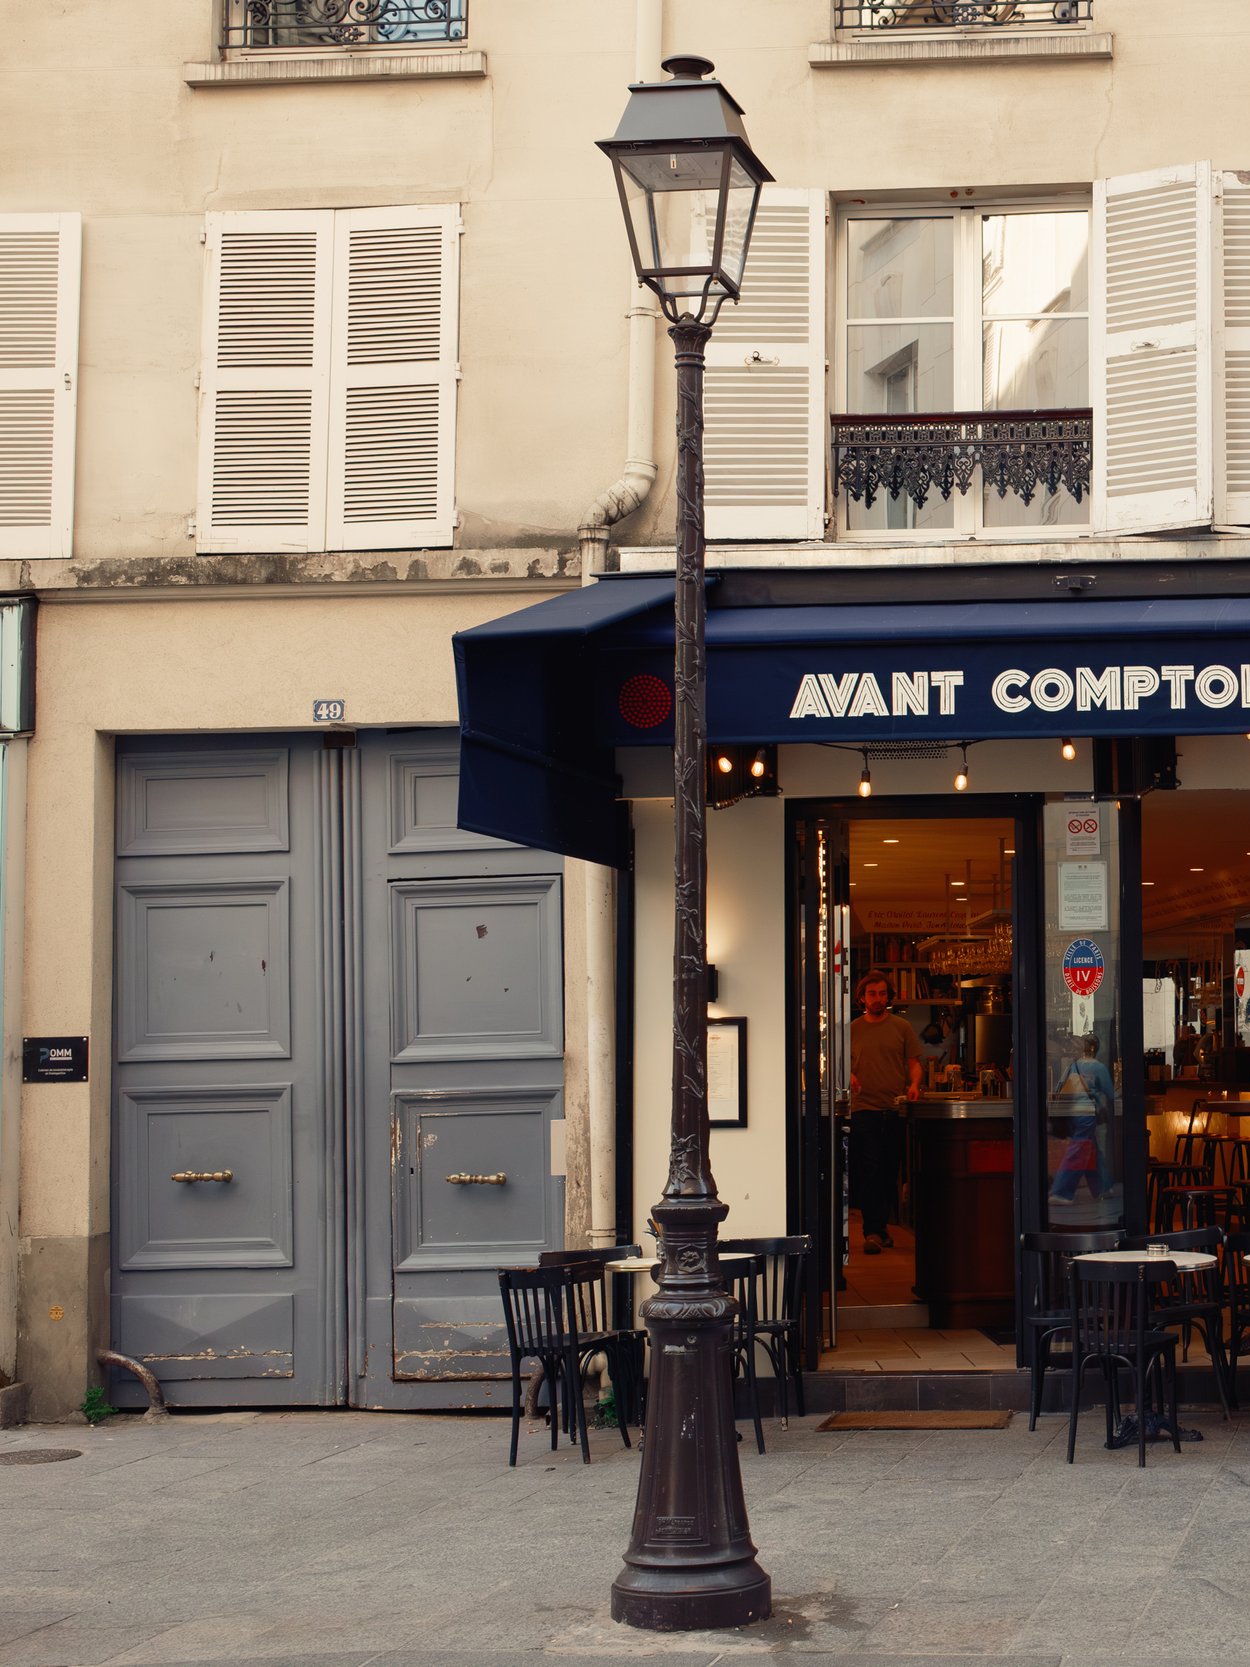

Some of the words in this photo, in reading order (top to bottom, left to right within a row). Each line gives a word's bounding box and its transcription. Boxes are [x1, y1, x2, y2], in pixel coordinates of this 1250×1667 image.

[790, 670, 964, 718] AVANT
[317, 702, 342, 719] 49
[1065, 944, 1076, 960] VILLE
[1089, 943, 1102, 960] PARIS
[1073, 956, 1094, 964] LICENCE
[1076, 970, 1091, 982] IV
[1085, 972, 1103, 995] BOISSONS
